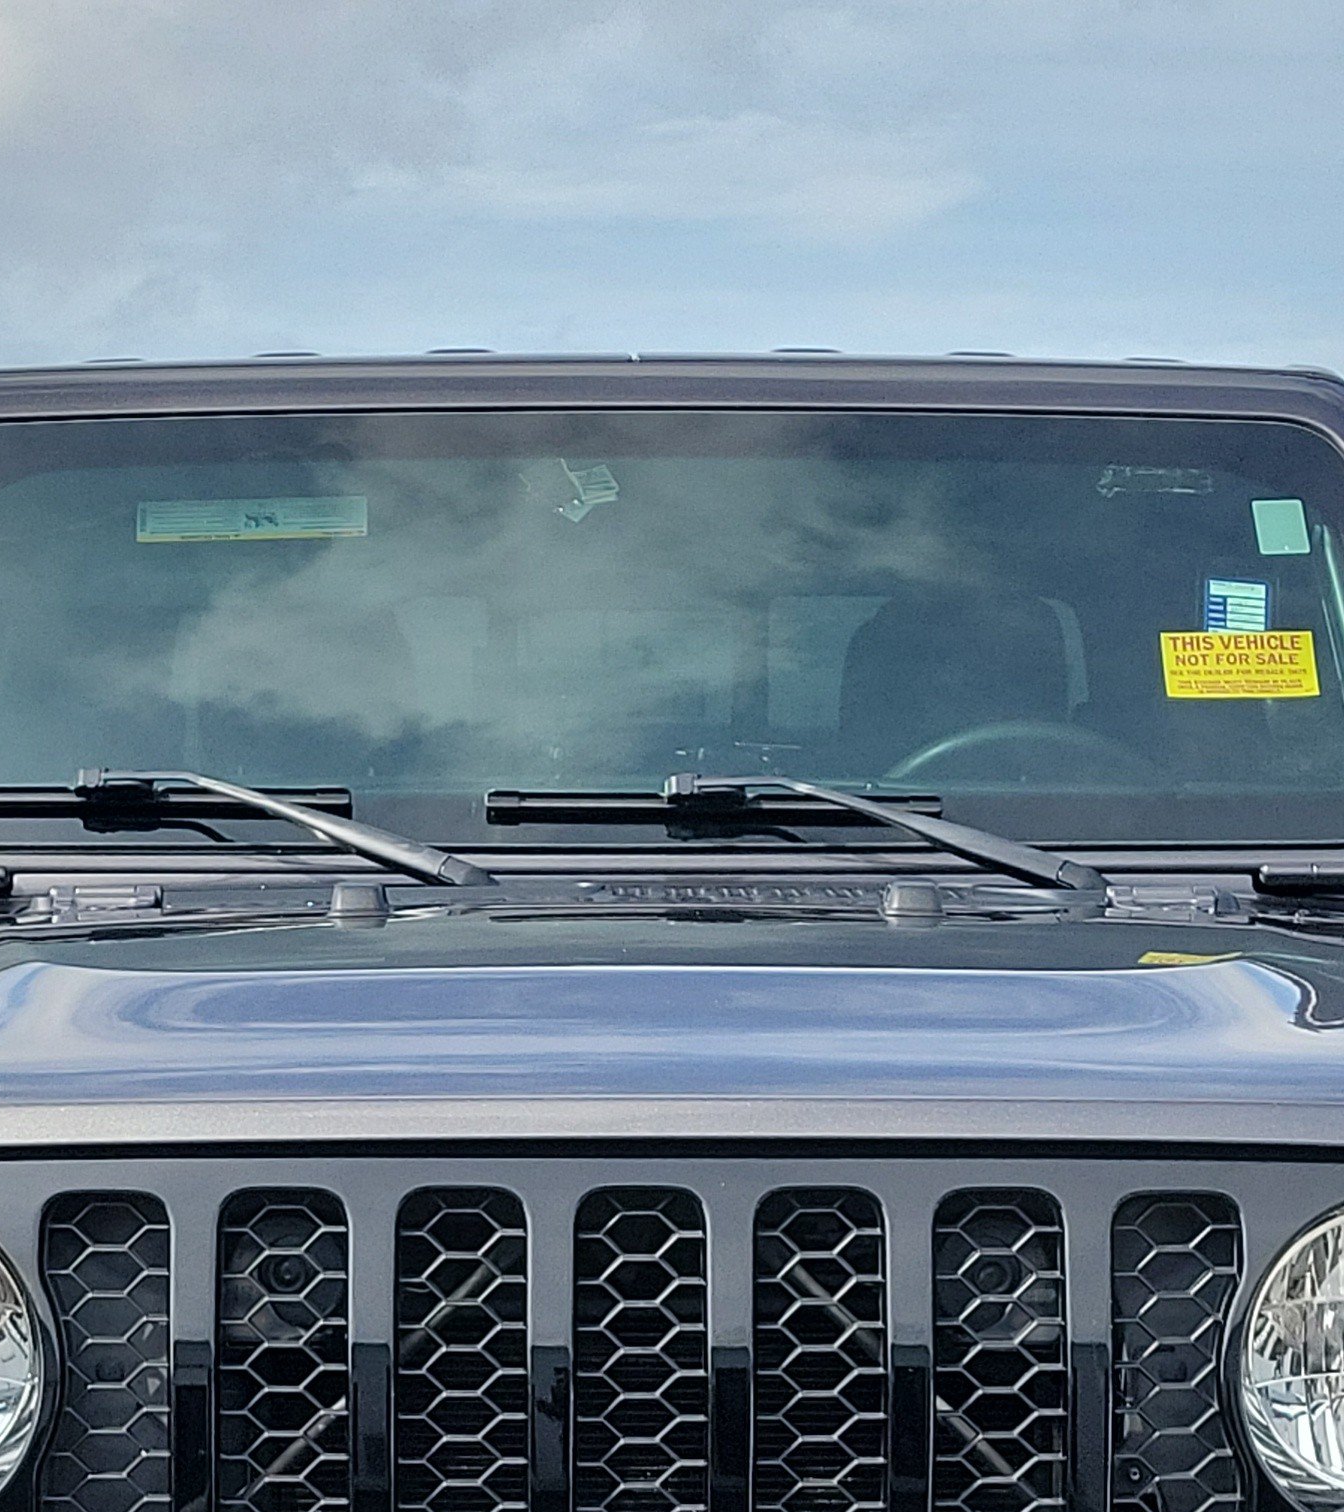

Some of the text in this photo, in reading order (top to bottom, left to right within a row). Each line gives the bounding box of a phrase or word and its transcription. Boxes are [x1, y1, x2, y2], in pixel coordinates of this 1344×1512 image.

[1169, 635, 1302, 652] THIS VEHICLE
[1175, 653, 1299, 666] NOT FOR SALE
